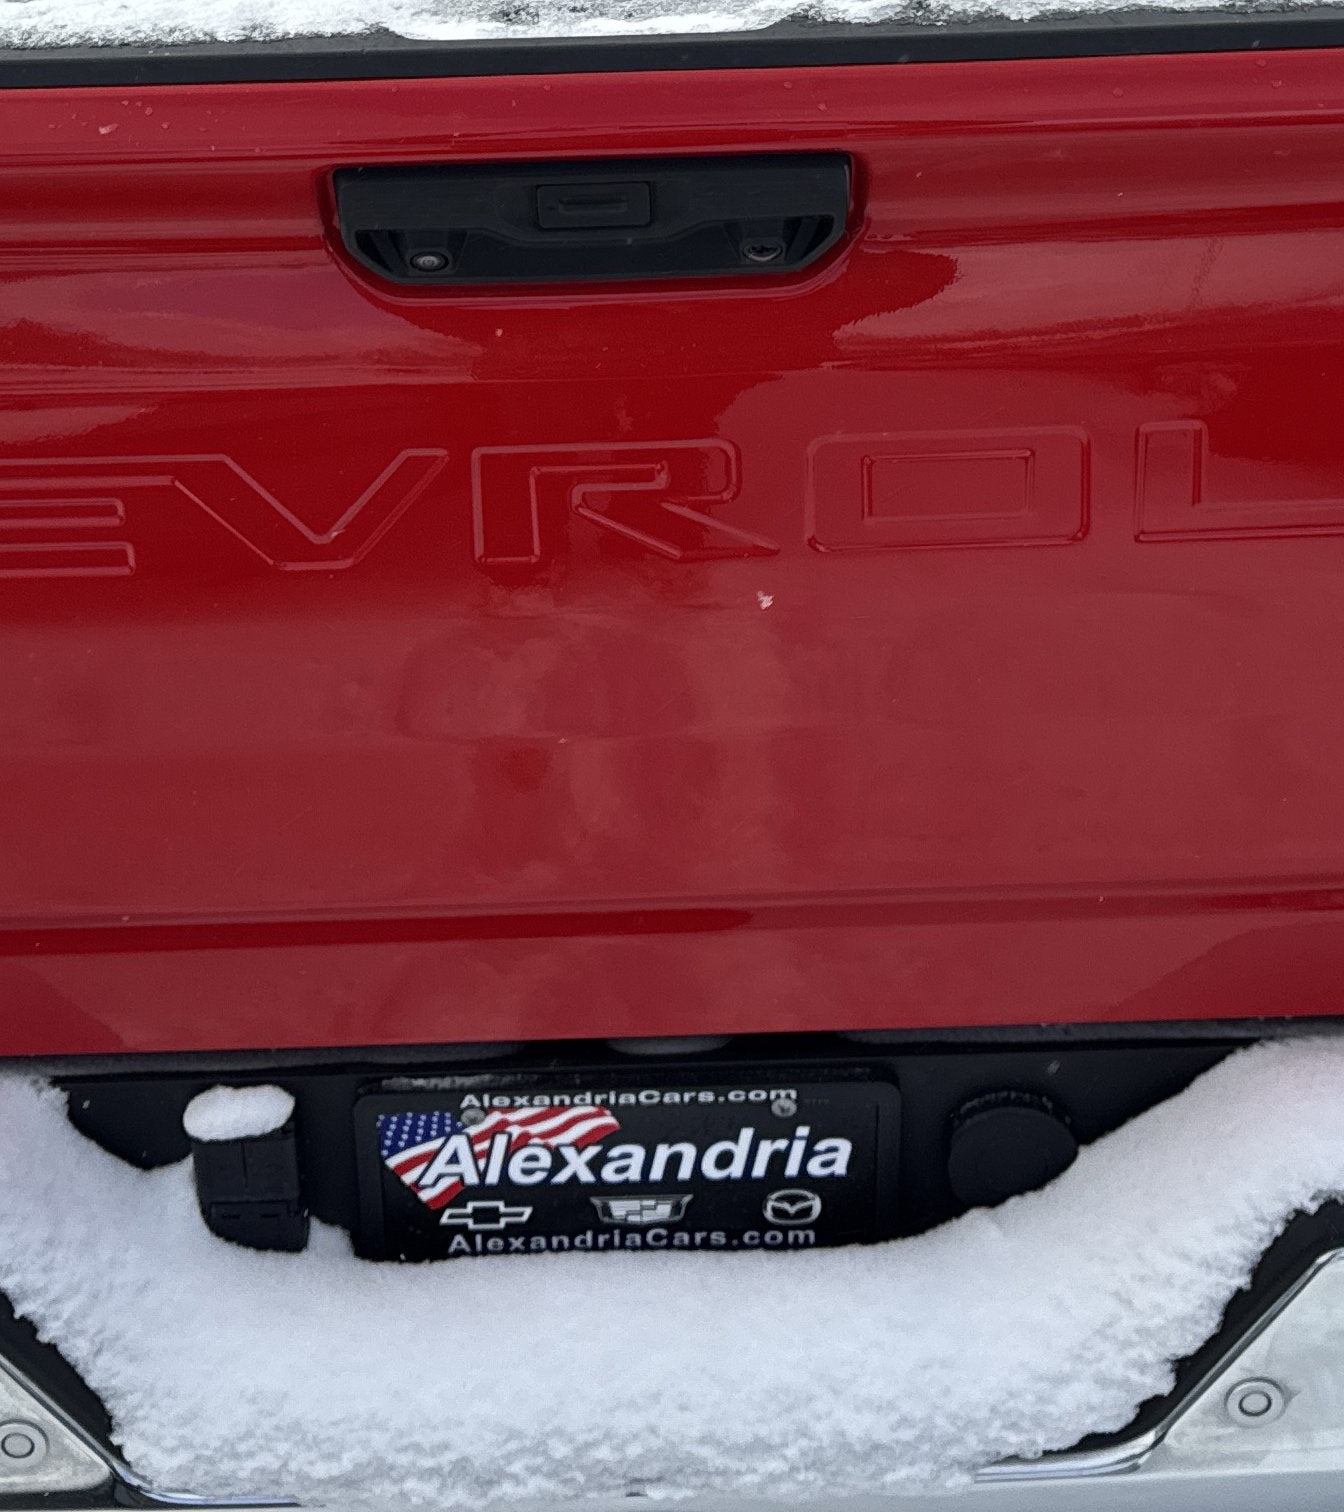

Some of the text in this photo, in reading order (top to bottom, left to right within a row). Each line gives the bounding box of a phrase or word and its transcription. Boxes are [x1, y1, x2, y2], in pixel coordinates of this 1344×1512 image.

[459, 1088, 798, 1108] AlexandriaCars.com
[419, 1125, 854, 1188] Alexandria
[447, 1226, 816, 1255] AlexandriaCars.com
